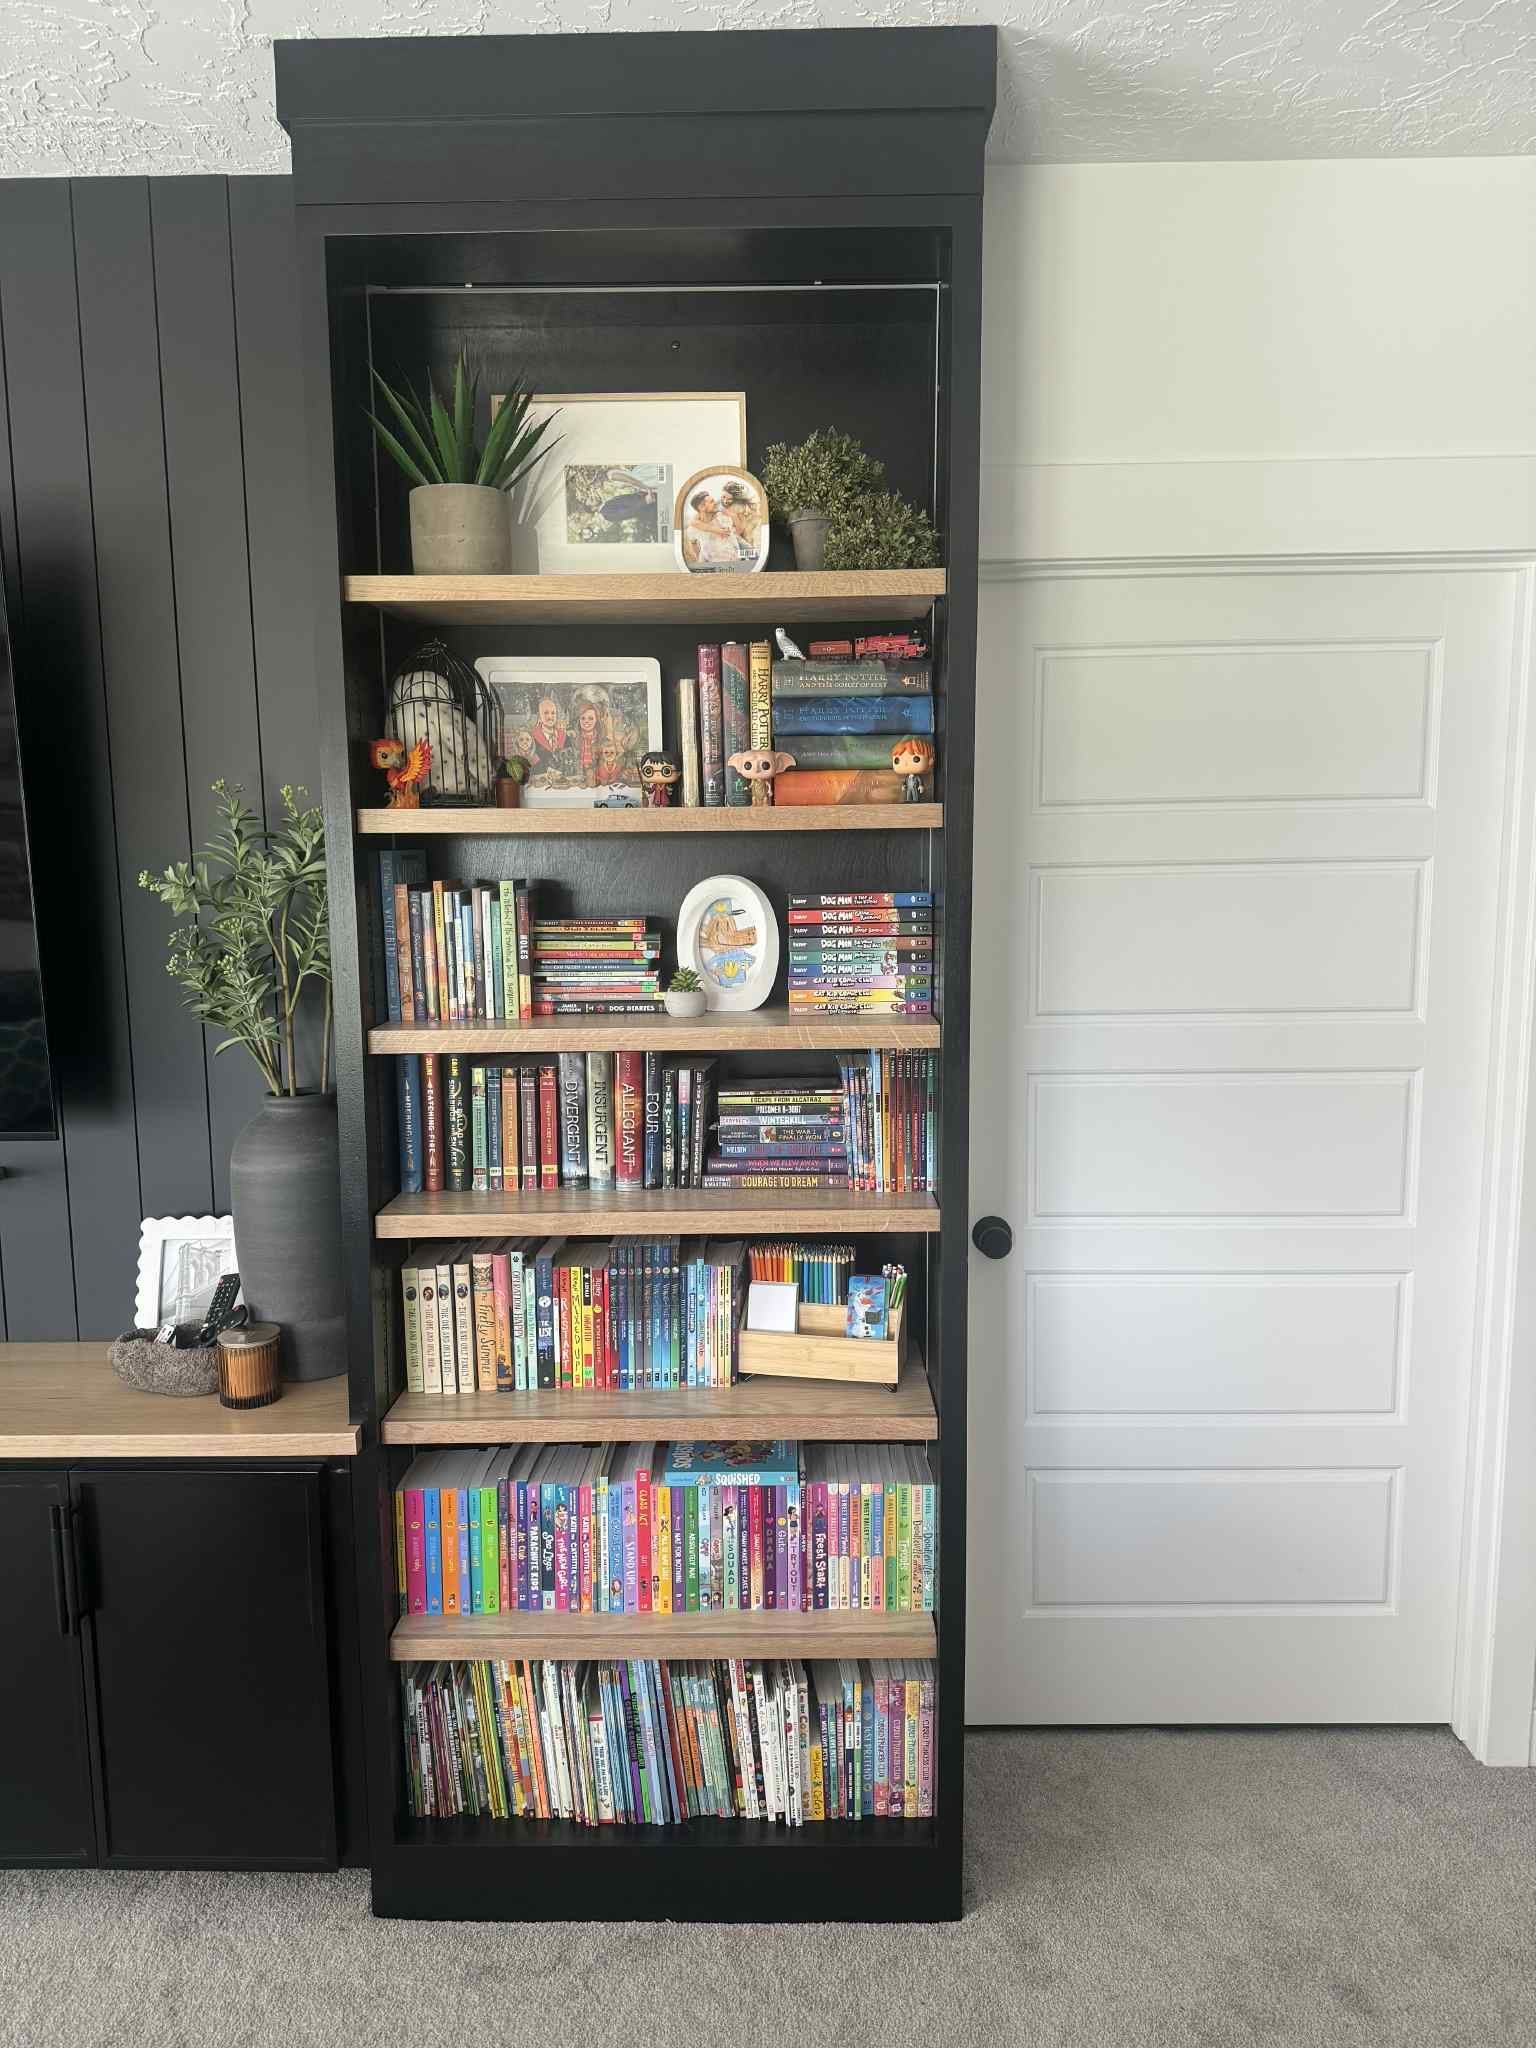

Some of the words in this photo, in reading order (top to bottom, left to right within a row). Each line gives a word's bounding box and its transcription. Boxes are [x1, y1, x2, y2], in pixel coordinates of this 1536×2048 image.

[758, 668, 768, 706] HARRY
[799, 673, 838, 681] HARRY
[758, 709, 769, 750] POTTER
[820, 896, 836, 905] DOG
[837, 896, 852, 905] MAN
[822, 912, 837, 921] DOG
[838, 912, 854, 921] MAN
[822, 925, 837, 934] DOG
[838, 925, 854, 934] MAN
[519, 935, 528, 960] HOLES
[820, 939, 836, 948] DOG
[838, 939, 852, 948] MAN
[822, 952, 836, 962] DOG
[838, 952, 852, 962] MAN
[822, 964, 836, 974] DOG
[838, 964, 852, 974] MAN
[428, 1090, 436, 1131] CATCHING
[566, 1081, 580, 1164] DIVERGENT
[594, 1081, 608, 1164] INSURGENT
[646, 1092, 659, 1134] FOUR
[664, 1108, 672, 1134] WILD
[760, 1116, 806, 1124] WINTERKILL
[621, 1082, 634, 1166] ALLEGIANT
[742, 1176, 778, 1187] COURAGE
[780, 1176, 790, 1187] TO
[792, 1176, 818, 1187] DREAM
[512, 1270, 522, 1310] OPERATION
[478, 1304, 495, 1336] Firefly
[514, 1313, 524, 1339] HAPPY
[561, 1298, 569, 1371] RESTART
[480, 1338, 496, 1374] Summer
[716, 1473, 760, 1485] SQUISHED
[582, 1516, 590, 1532] KATIE
[518, 1532, 526, 1542] Art
[530, 1526, 539, 1572] PARACHUTE
[542, 1532, 552, 1550] Sea
[674, 1533, 682, 1544] NAT
[688, 1533, 696, 1565] ABSOLUTELY
[815, 1534, 826, 1560] Fresh
[518, 1546, 526, 1560] Club
[543, 1550, 553, 1570] Legs
[556, 1554, 566, 1570] NEW
[570, 1542, 578, 1574] CATSITTER
[582, 1543, 590, 1575] CATSITTER
[625, 1542, 634, 1568] STAND
[674, 1546, 682, 1557] FOR
[558, 1570, 568, 1590] GIRL
[626, 1571, 634, 1585] UP!
[688, 1567, 696, 1579] NAT
[790, 1546, 798, 1592] TRYOUT
[800, 1716, 808, 1749] Colors
[863, 1726, 872, 1743] JUST
[864, 1744, 872, 1780] PRETEND
